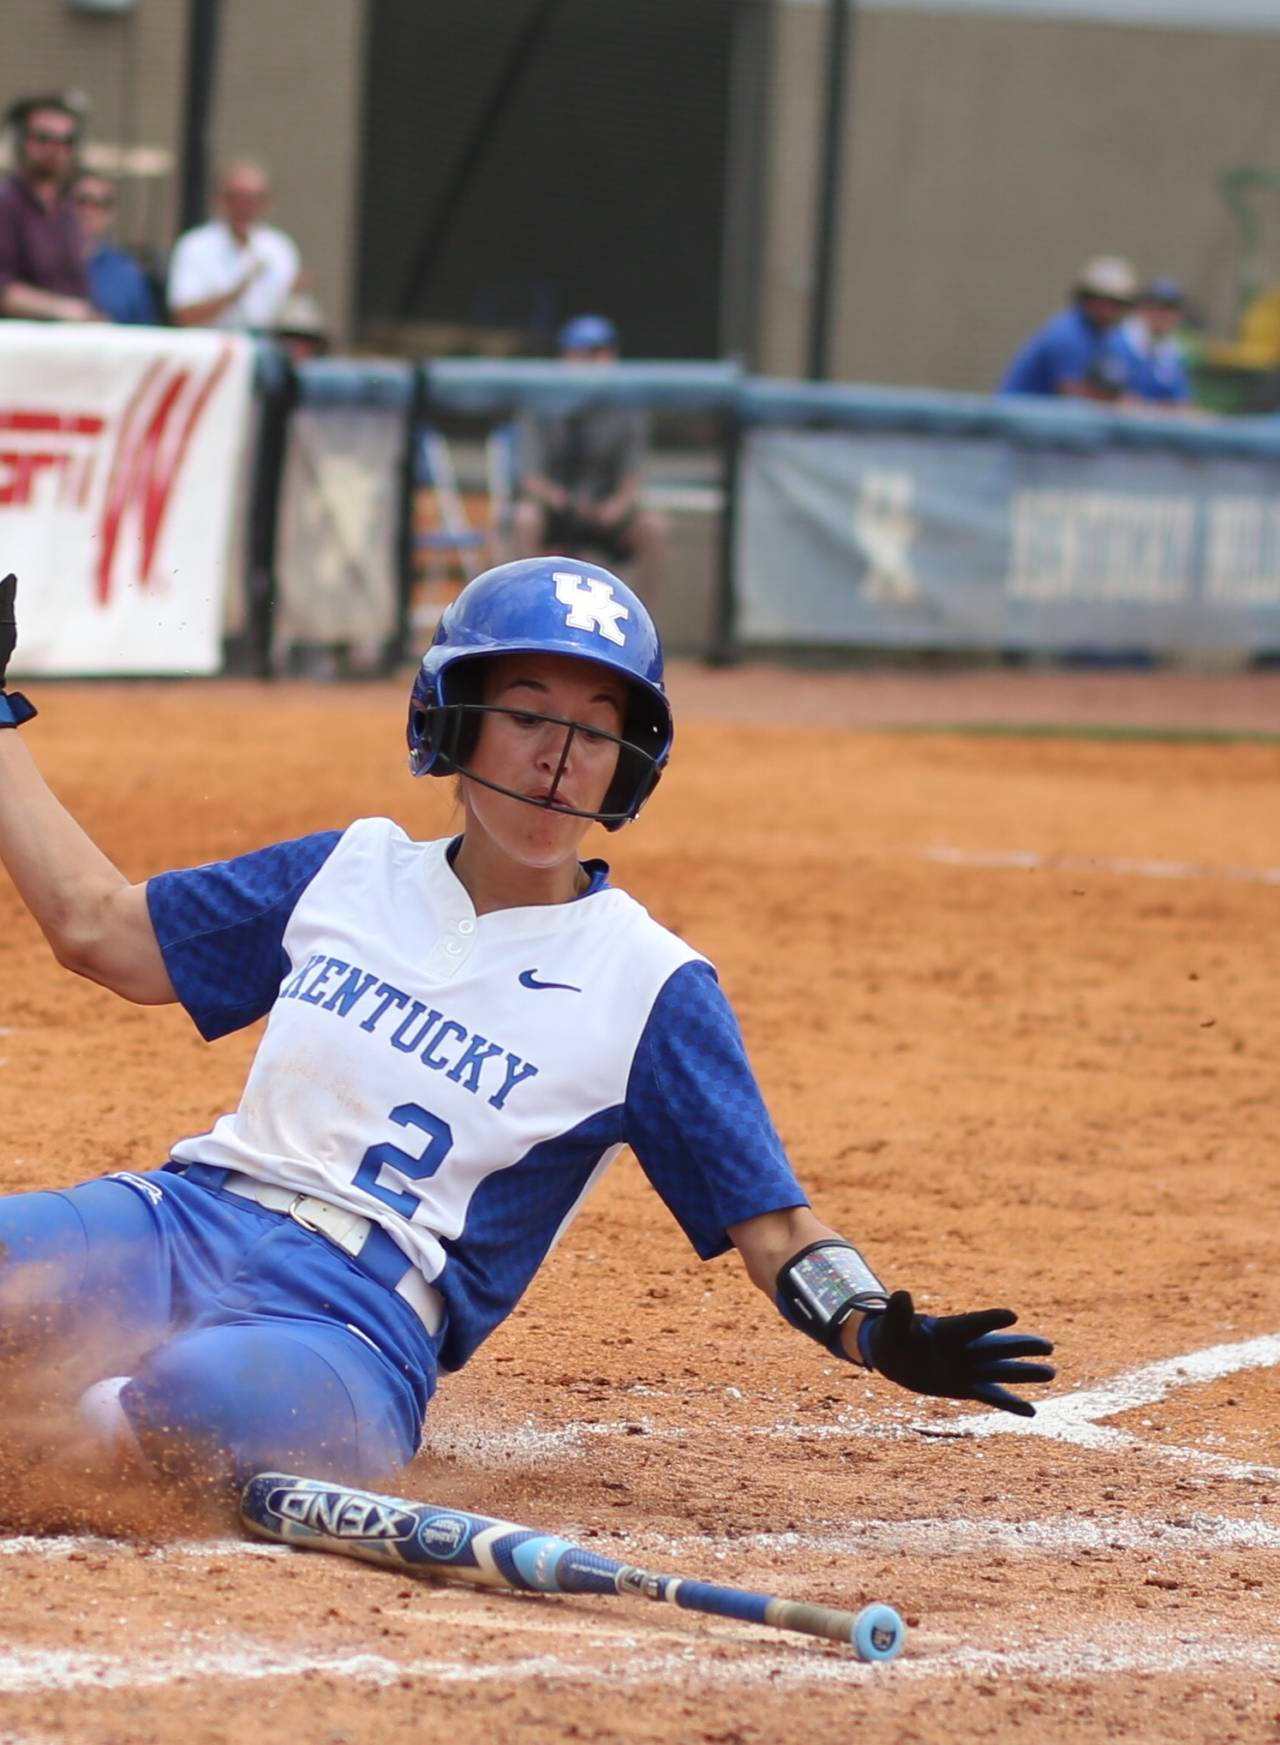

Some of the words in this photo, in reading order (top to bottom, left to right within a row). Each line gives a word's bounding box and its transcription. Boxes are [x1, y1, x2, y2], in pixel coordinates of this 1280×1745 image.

[552, 571, 629, 648] UK
[280, 955, 539, 1110] KENTUCKY
[352, 1101, 454, 1219] 2
